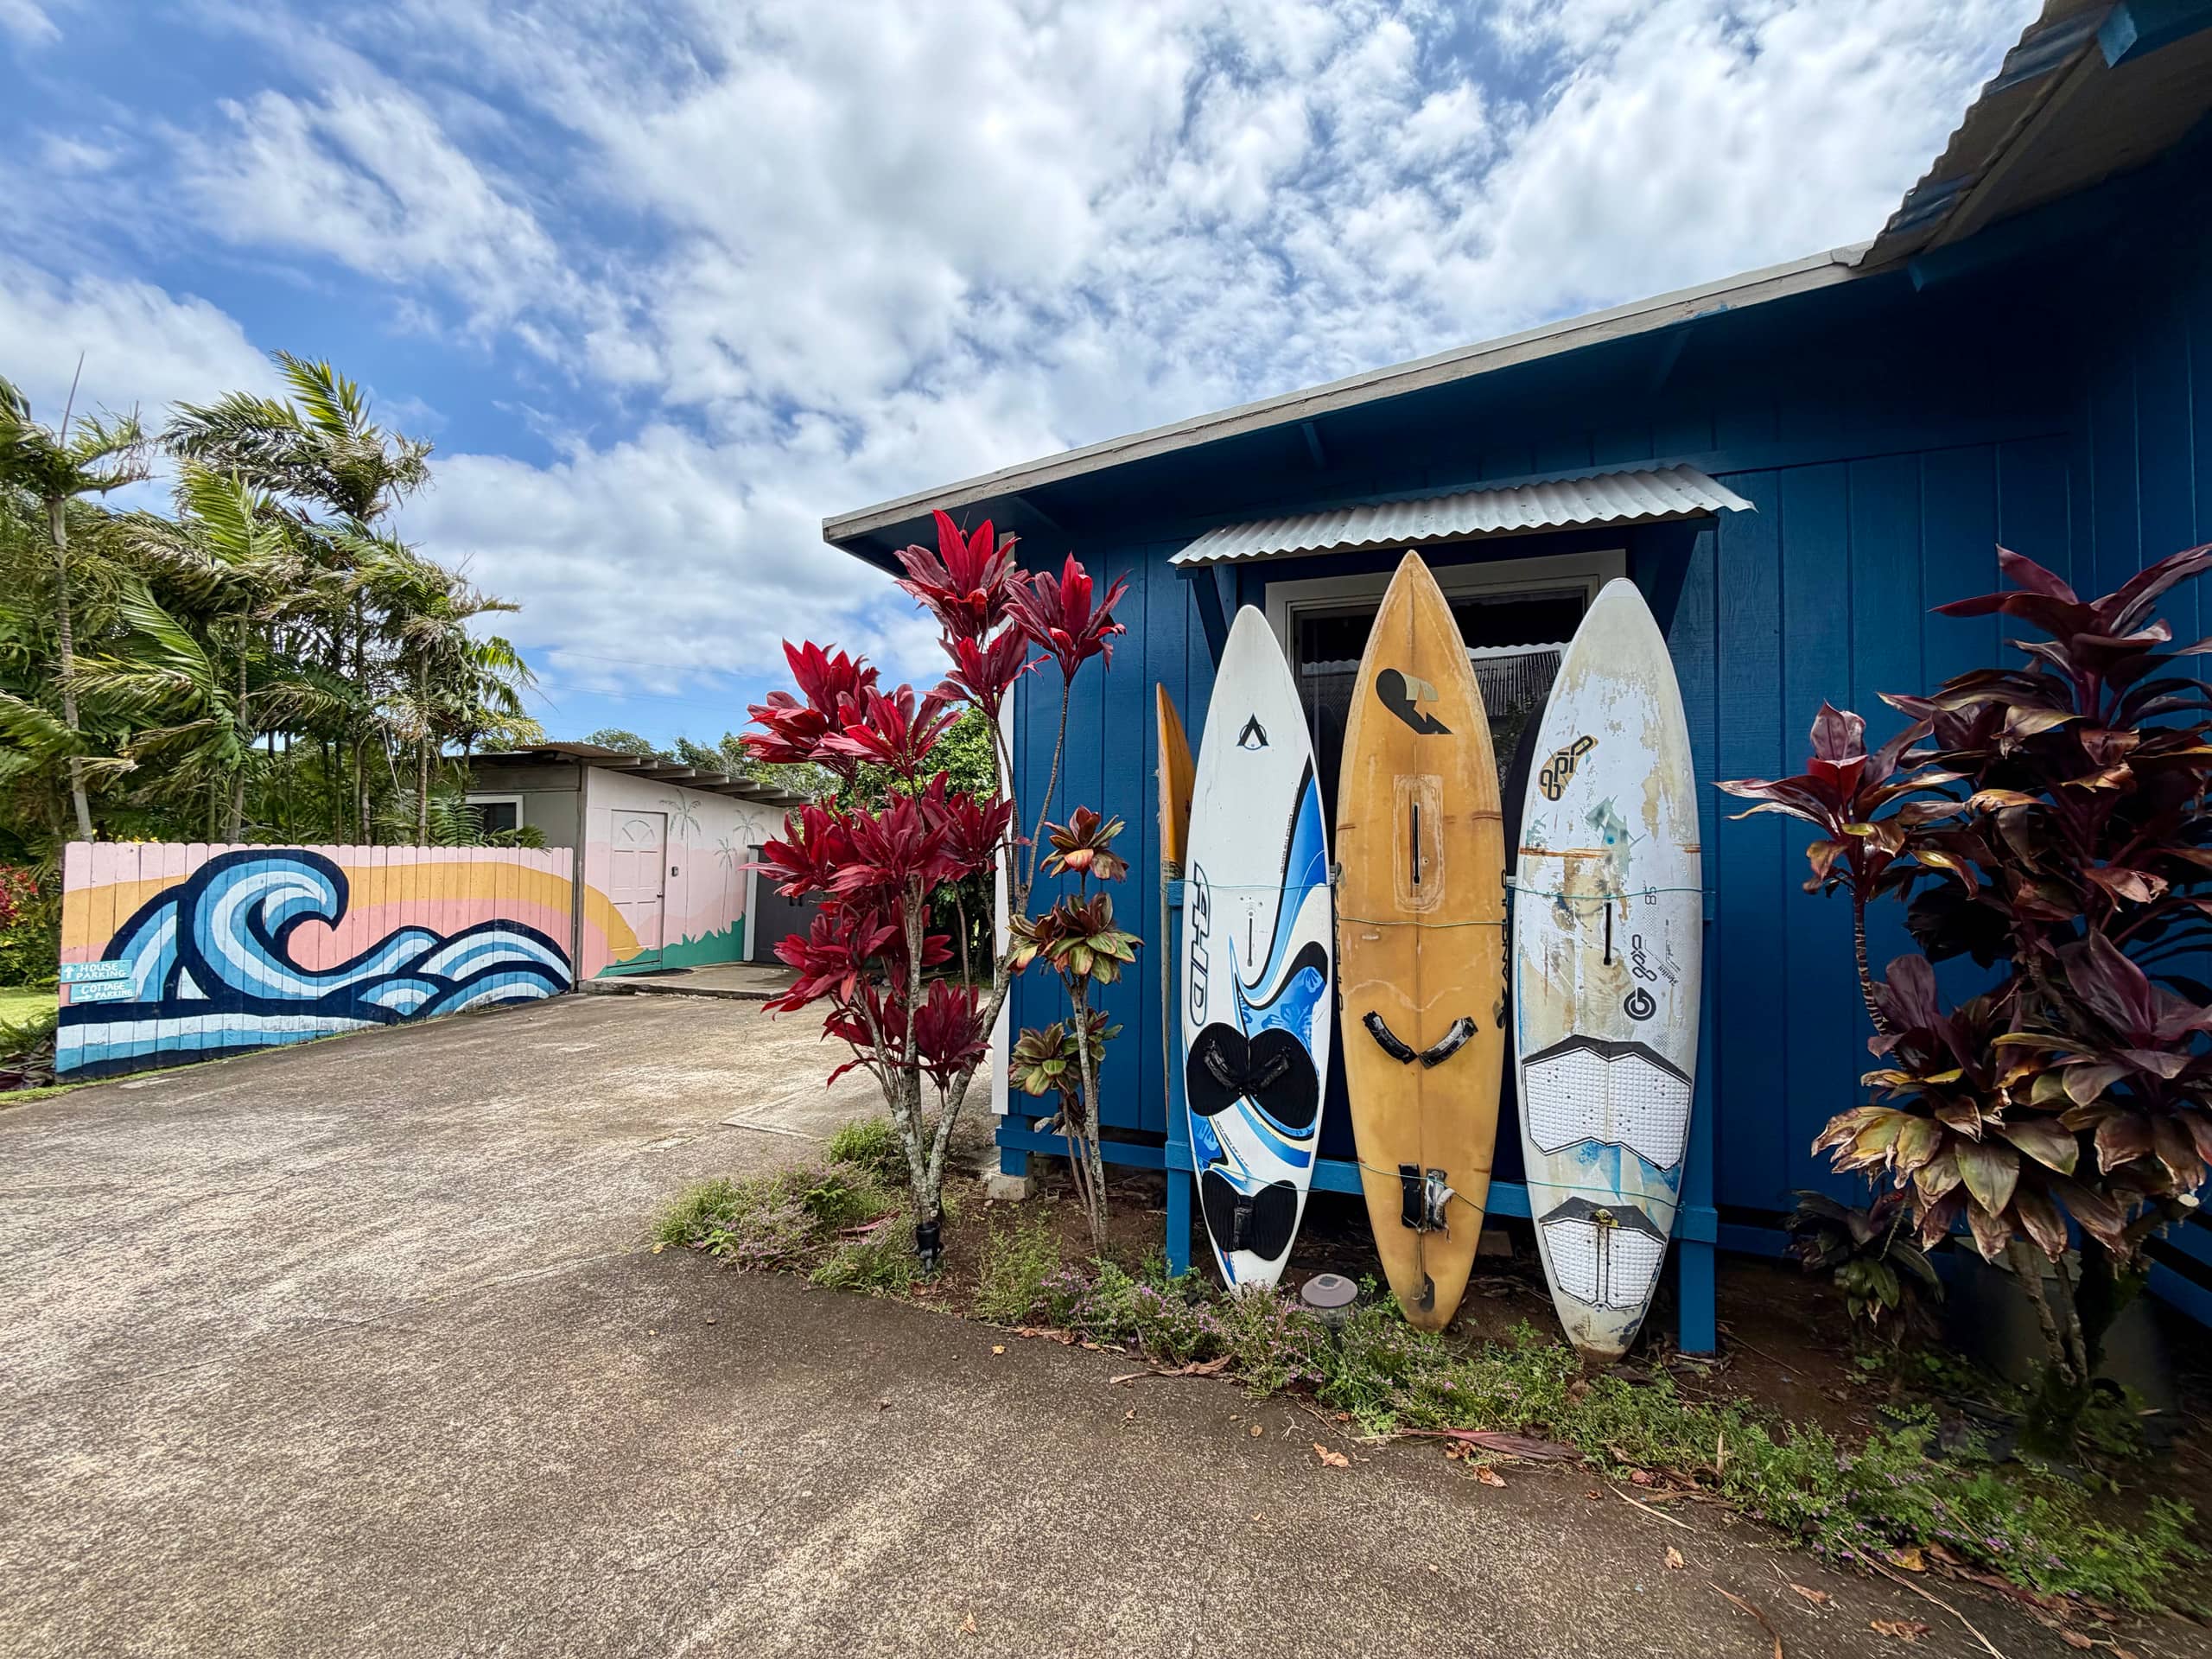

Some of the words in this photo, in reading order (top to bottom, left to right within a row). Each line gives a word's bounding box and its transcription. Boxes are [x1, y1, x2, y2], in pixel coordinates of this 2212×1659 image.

[1190, 860, 1211, 1027] AHD
[80, 963, 118, 972] HOUSE
[76, 969, 126, 980] PARKING
[81, 982, 124, 995] COTTAGE
[95, 989, 132, 999] PARKING
